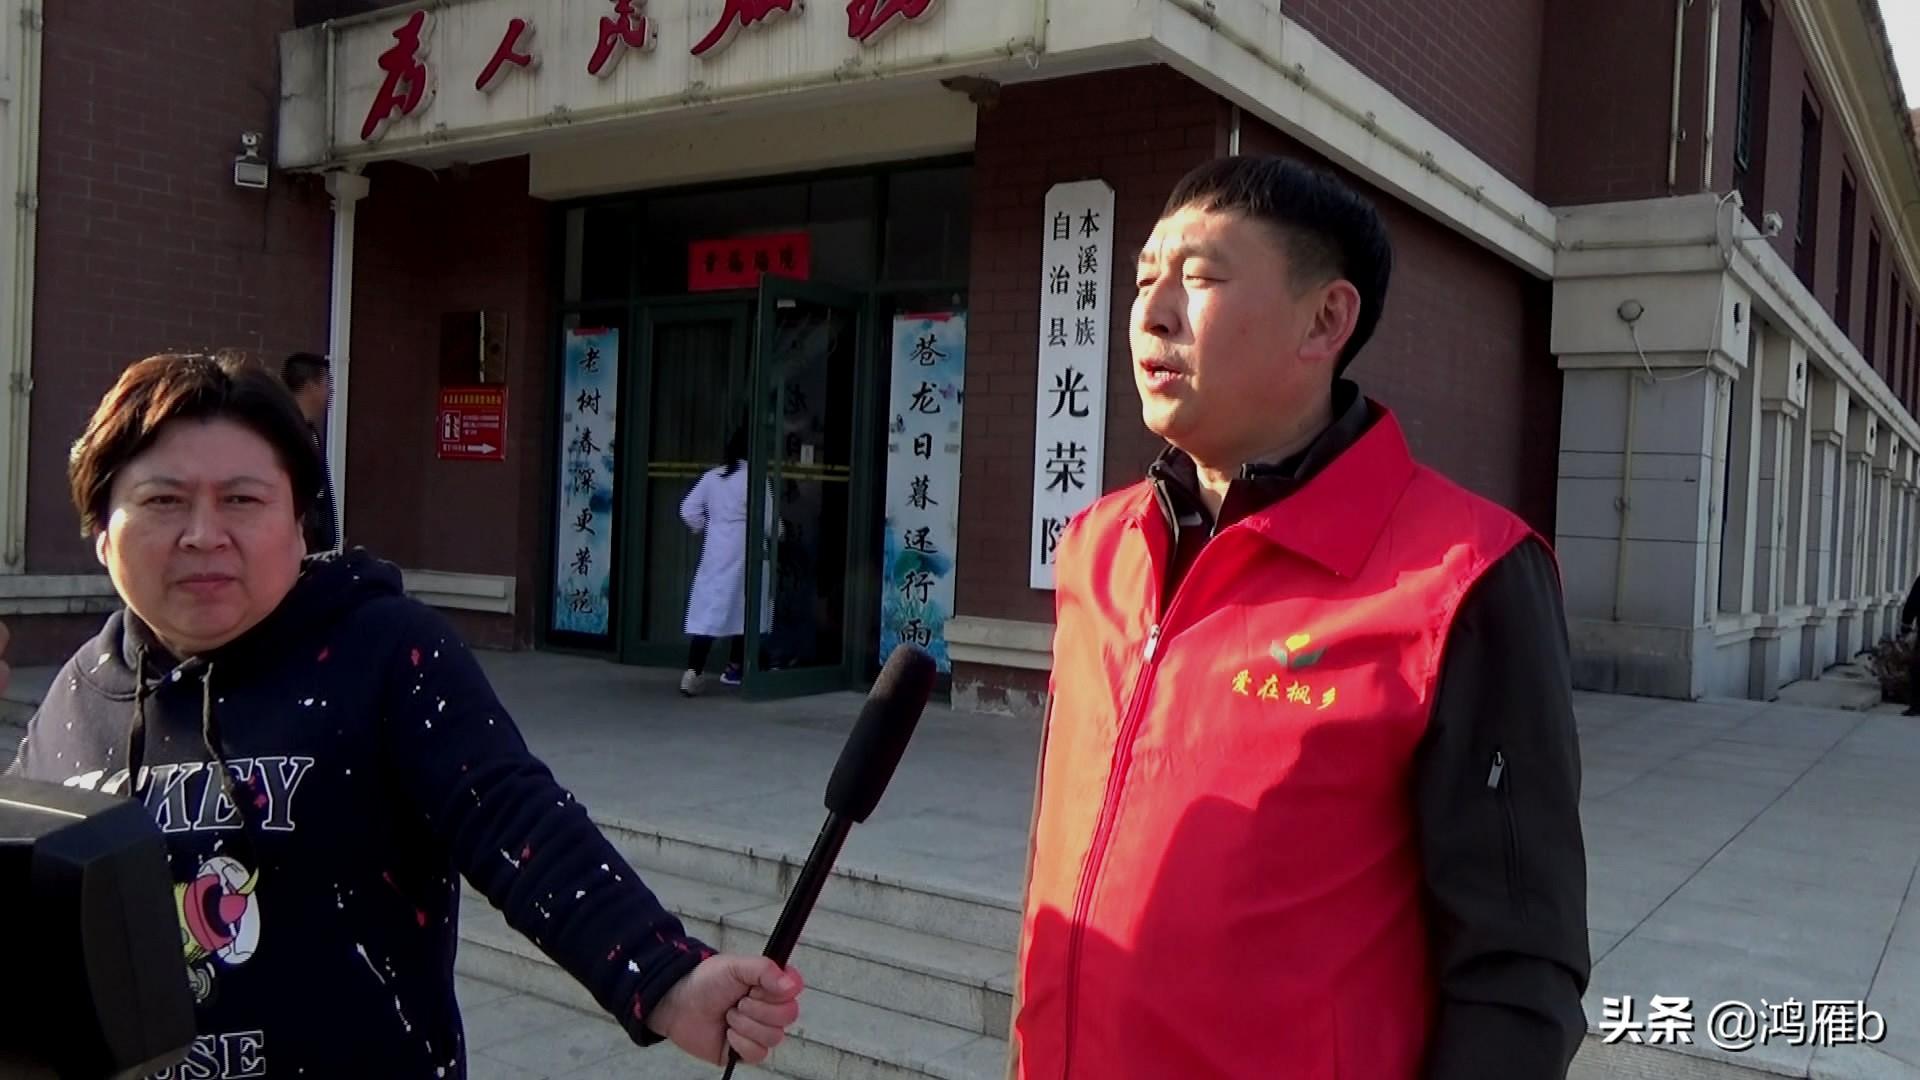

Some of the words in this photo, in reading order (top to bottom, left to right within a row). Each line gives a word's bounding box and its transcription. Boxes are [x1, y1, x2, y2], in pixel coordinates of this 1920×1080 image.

[361, 0, 932, 141] 为人民
[1047, 210, 1071, 348] 自治县
[1074, 208, 1100, 346] 本溪满族
[899, 334, 947, 648] 苍龙日暮还行雨
[1231, 669, 1336, 710] 爱在枫乡
